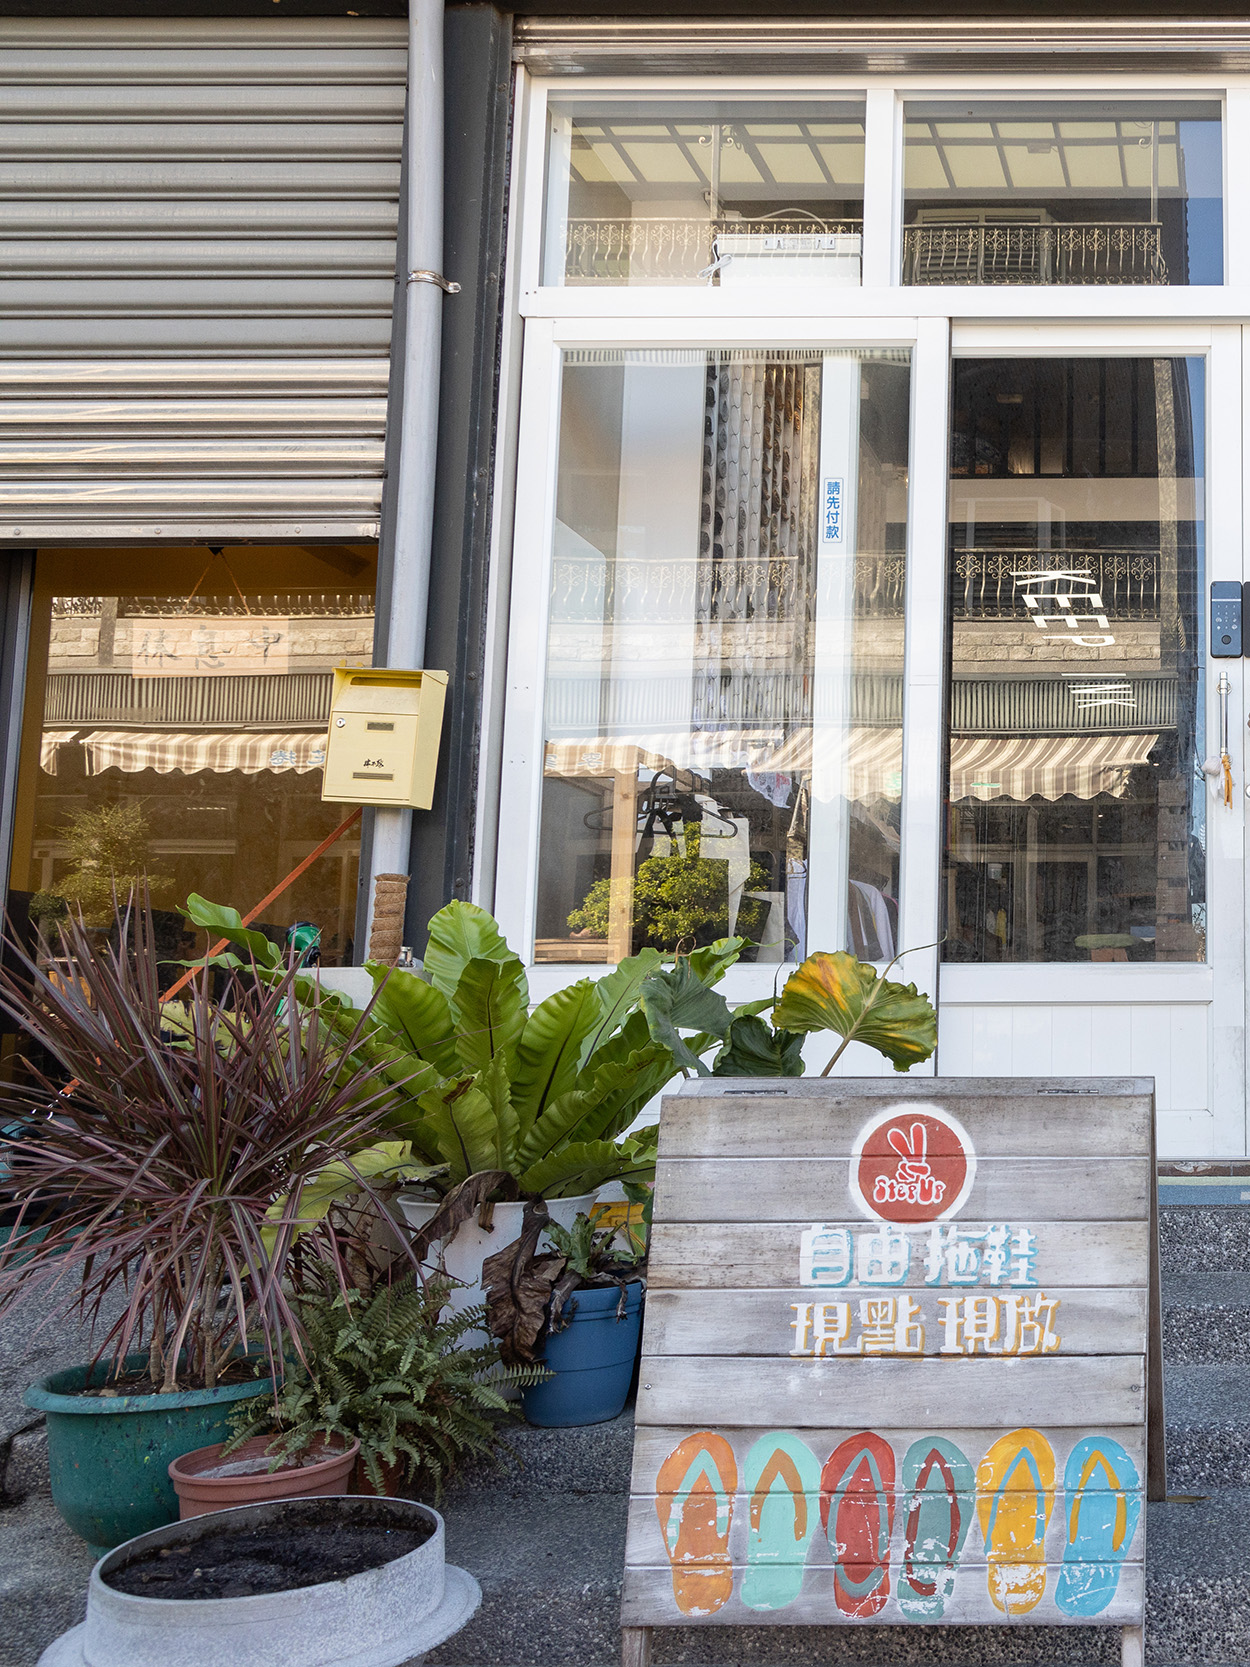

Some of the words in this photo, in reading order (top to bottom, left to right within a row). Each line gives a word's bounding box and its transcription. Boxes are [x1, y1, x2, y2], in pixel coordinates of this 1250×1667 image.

[825, 481, 841, 539] 請先付款
[1009, 569, 1116, 647] KEEP
[136, 624, 284, 670] 休息中
